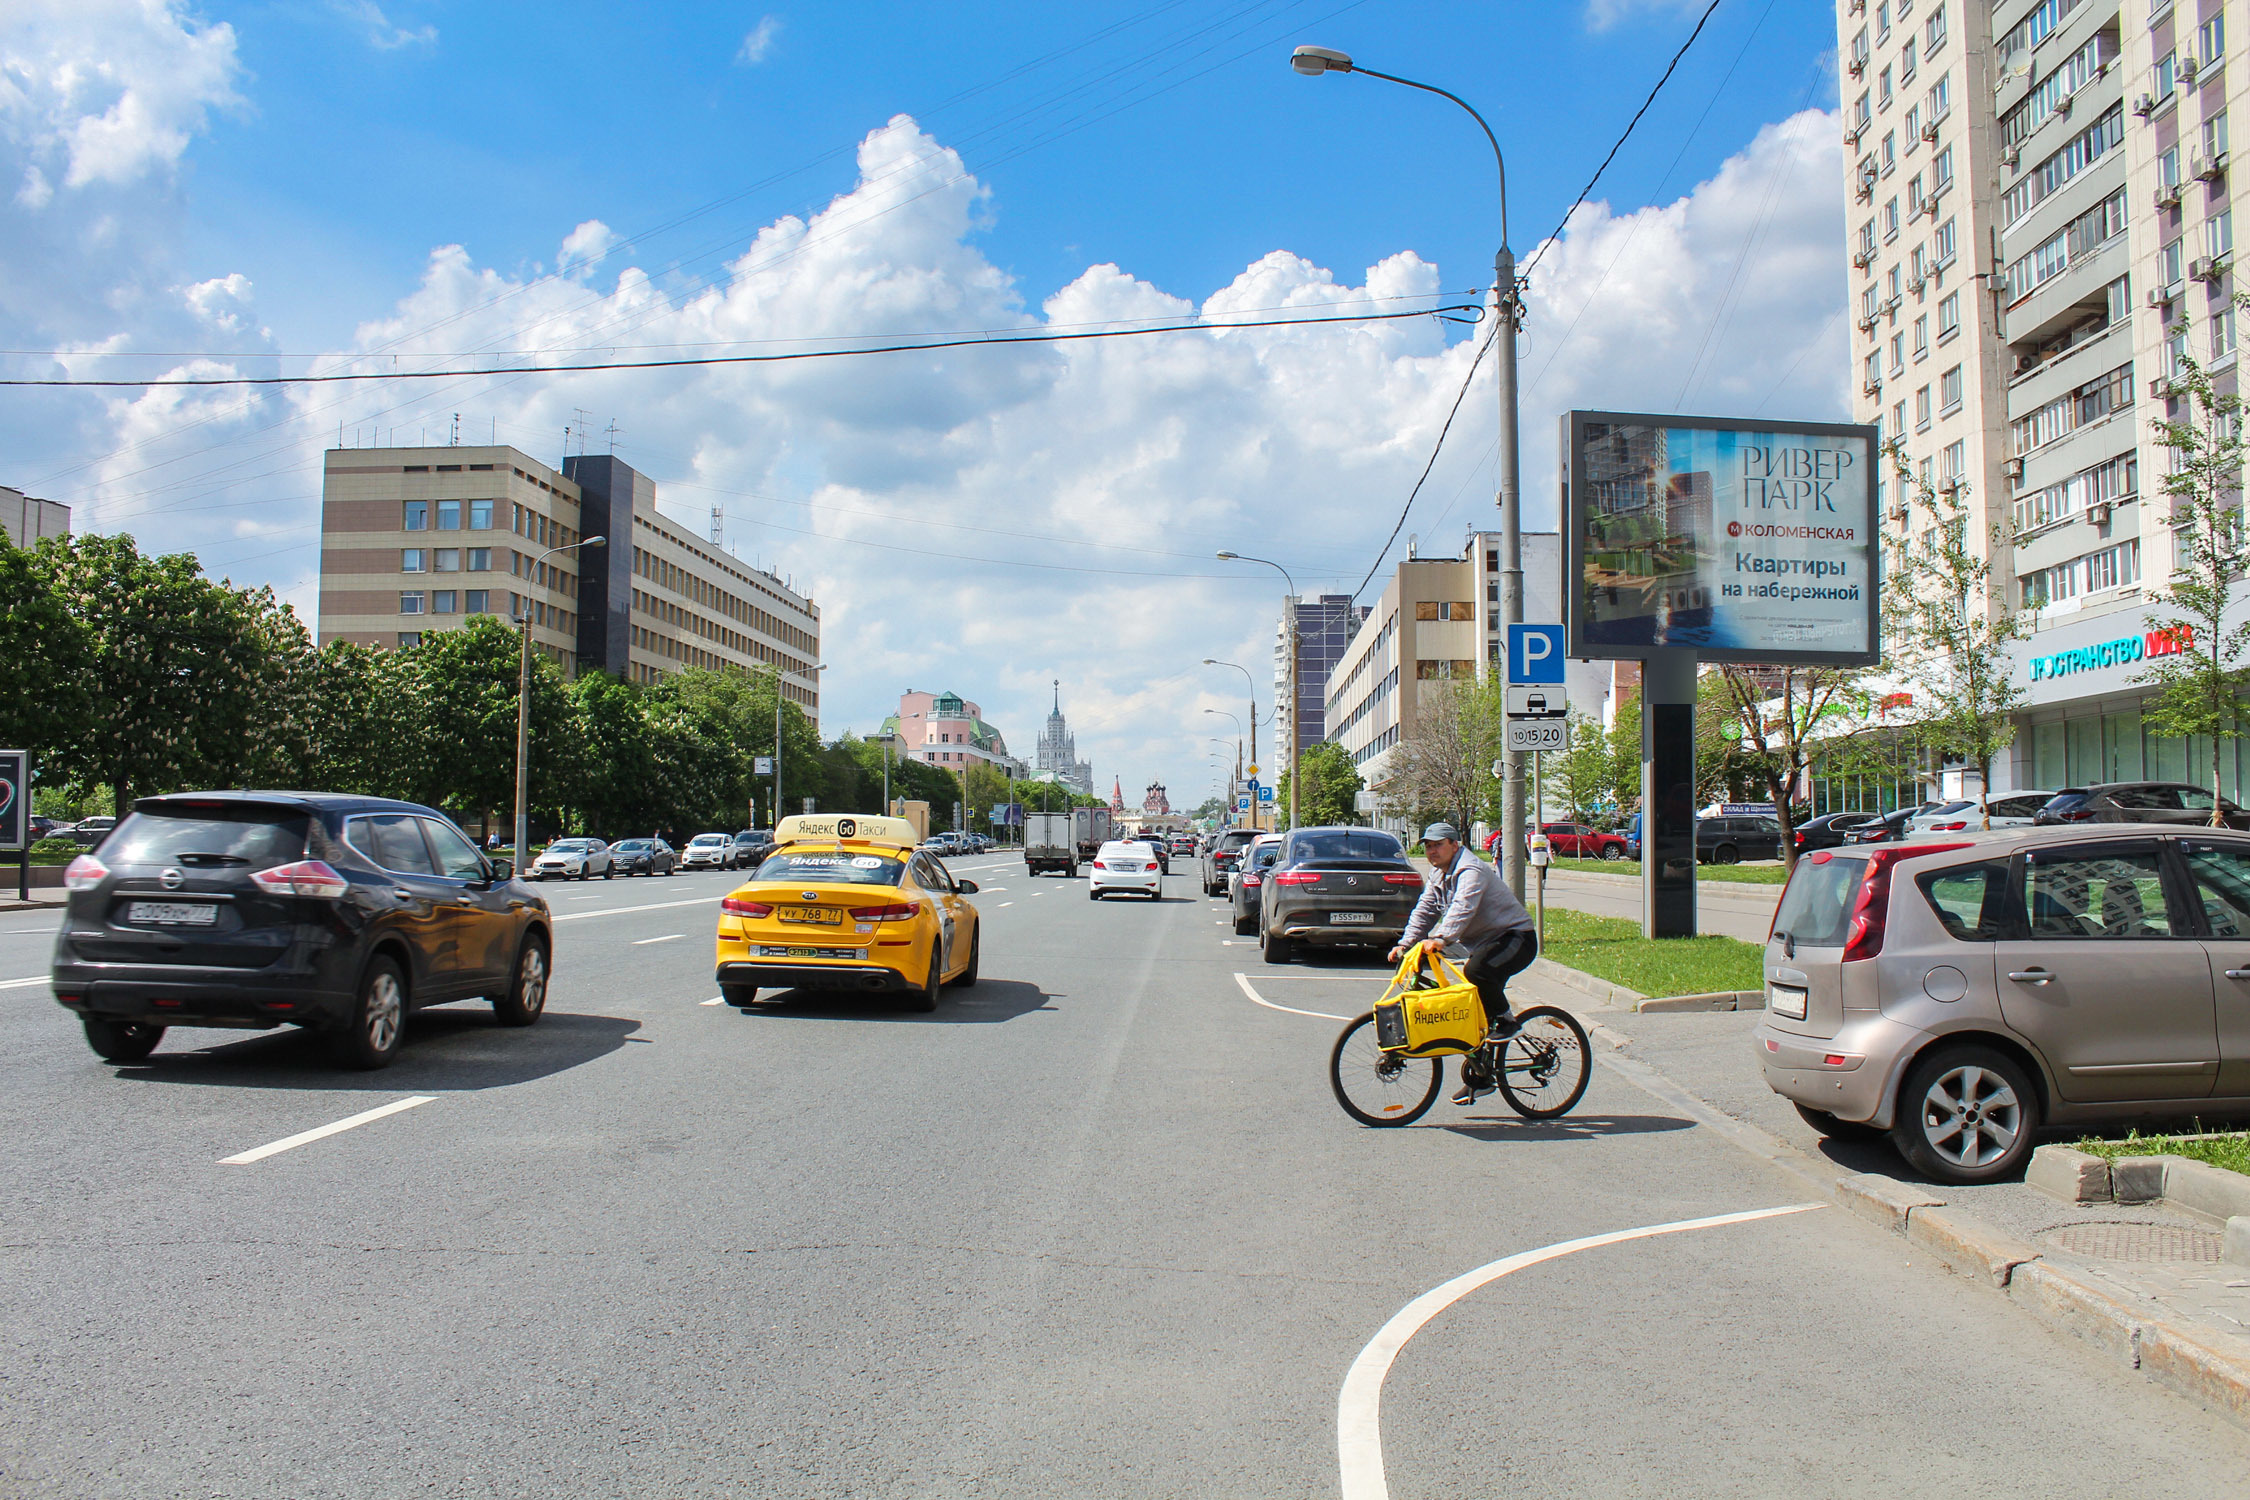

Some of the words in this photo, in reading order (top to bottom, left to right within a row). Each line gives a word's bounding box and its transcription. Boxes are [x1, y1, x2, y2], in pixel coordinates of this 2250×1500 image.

[1731, 445, 1854, 480] РИВЕР
[1744, 477, 1837, 512] ПАРК
[1745, 524, 1854, 540] КОЛОМЕНСКАЯ
[1735, 551, 1847, 578] Квартиры
[1721, 583, 1742, 597] на
[1747, 581, 1860, 602] набережной
[1522, 631, 1552, 676] P
[2029, 635, 2143, 680] ПРОСТРАНСТВО
[1514, 731, 1524, 740] 10
[1527, 730, 1538, 741] 15
[1543, 728, 1560, 741] 20
[798, 820, 834, 835] Яндекс
[839, 821, 855, 836] Go
[858, 821, 886, 836] Такси
[788, 856, 847, 866] Яндекс
[801, 908, 822, 919] 768
[827, 909, 838, 918] 77
[1414, 1010, 1450, 1025] Яндекс
[1452, 1007, 1470, 1021] Еда
